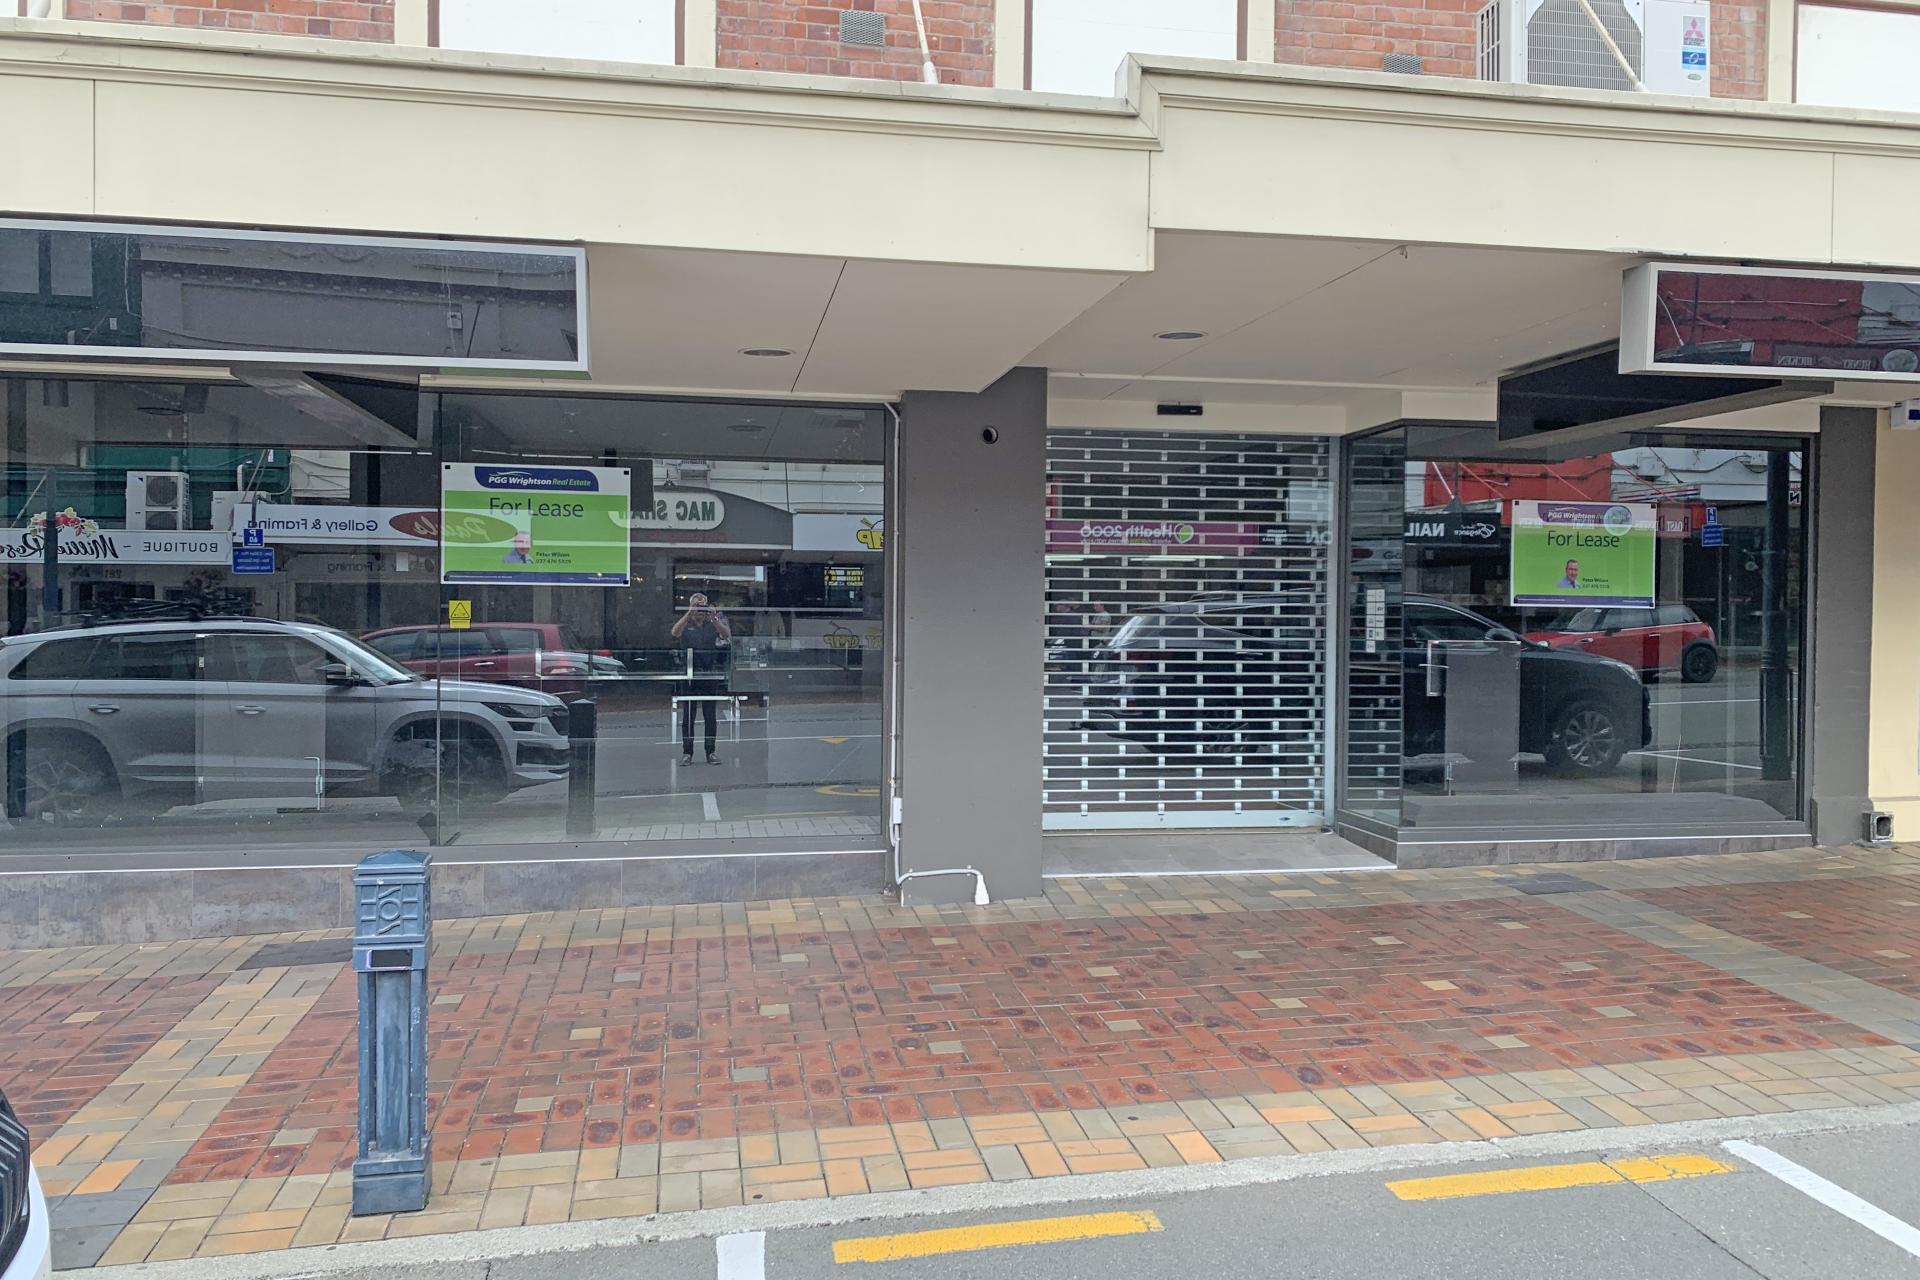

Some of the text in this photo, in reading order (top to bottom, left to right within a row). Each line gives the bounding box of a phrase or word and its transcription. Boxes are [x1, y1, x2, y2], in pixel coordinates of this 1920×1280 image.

[488, 476, 592, 487] PGG Wrightson Real Estate
[489, 497, 584, 518] For Lease
[1547, 511, 1563, 519] PGG
[1563, 512, 1596, 520] Wrightson
[1547, 530, 1620, 547] For Lease
